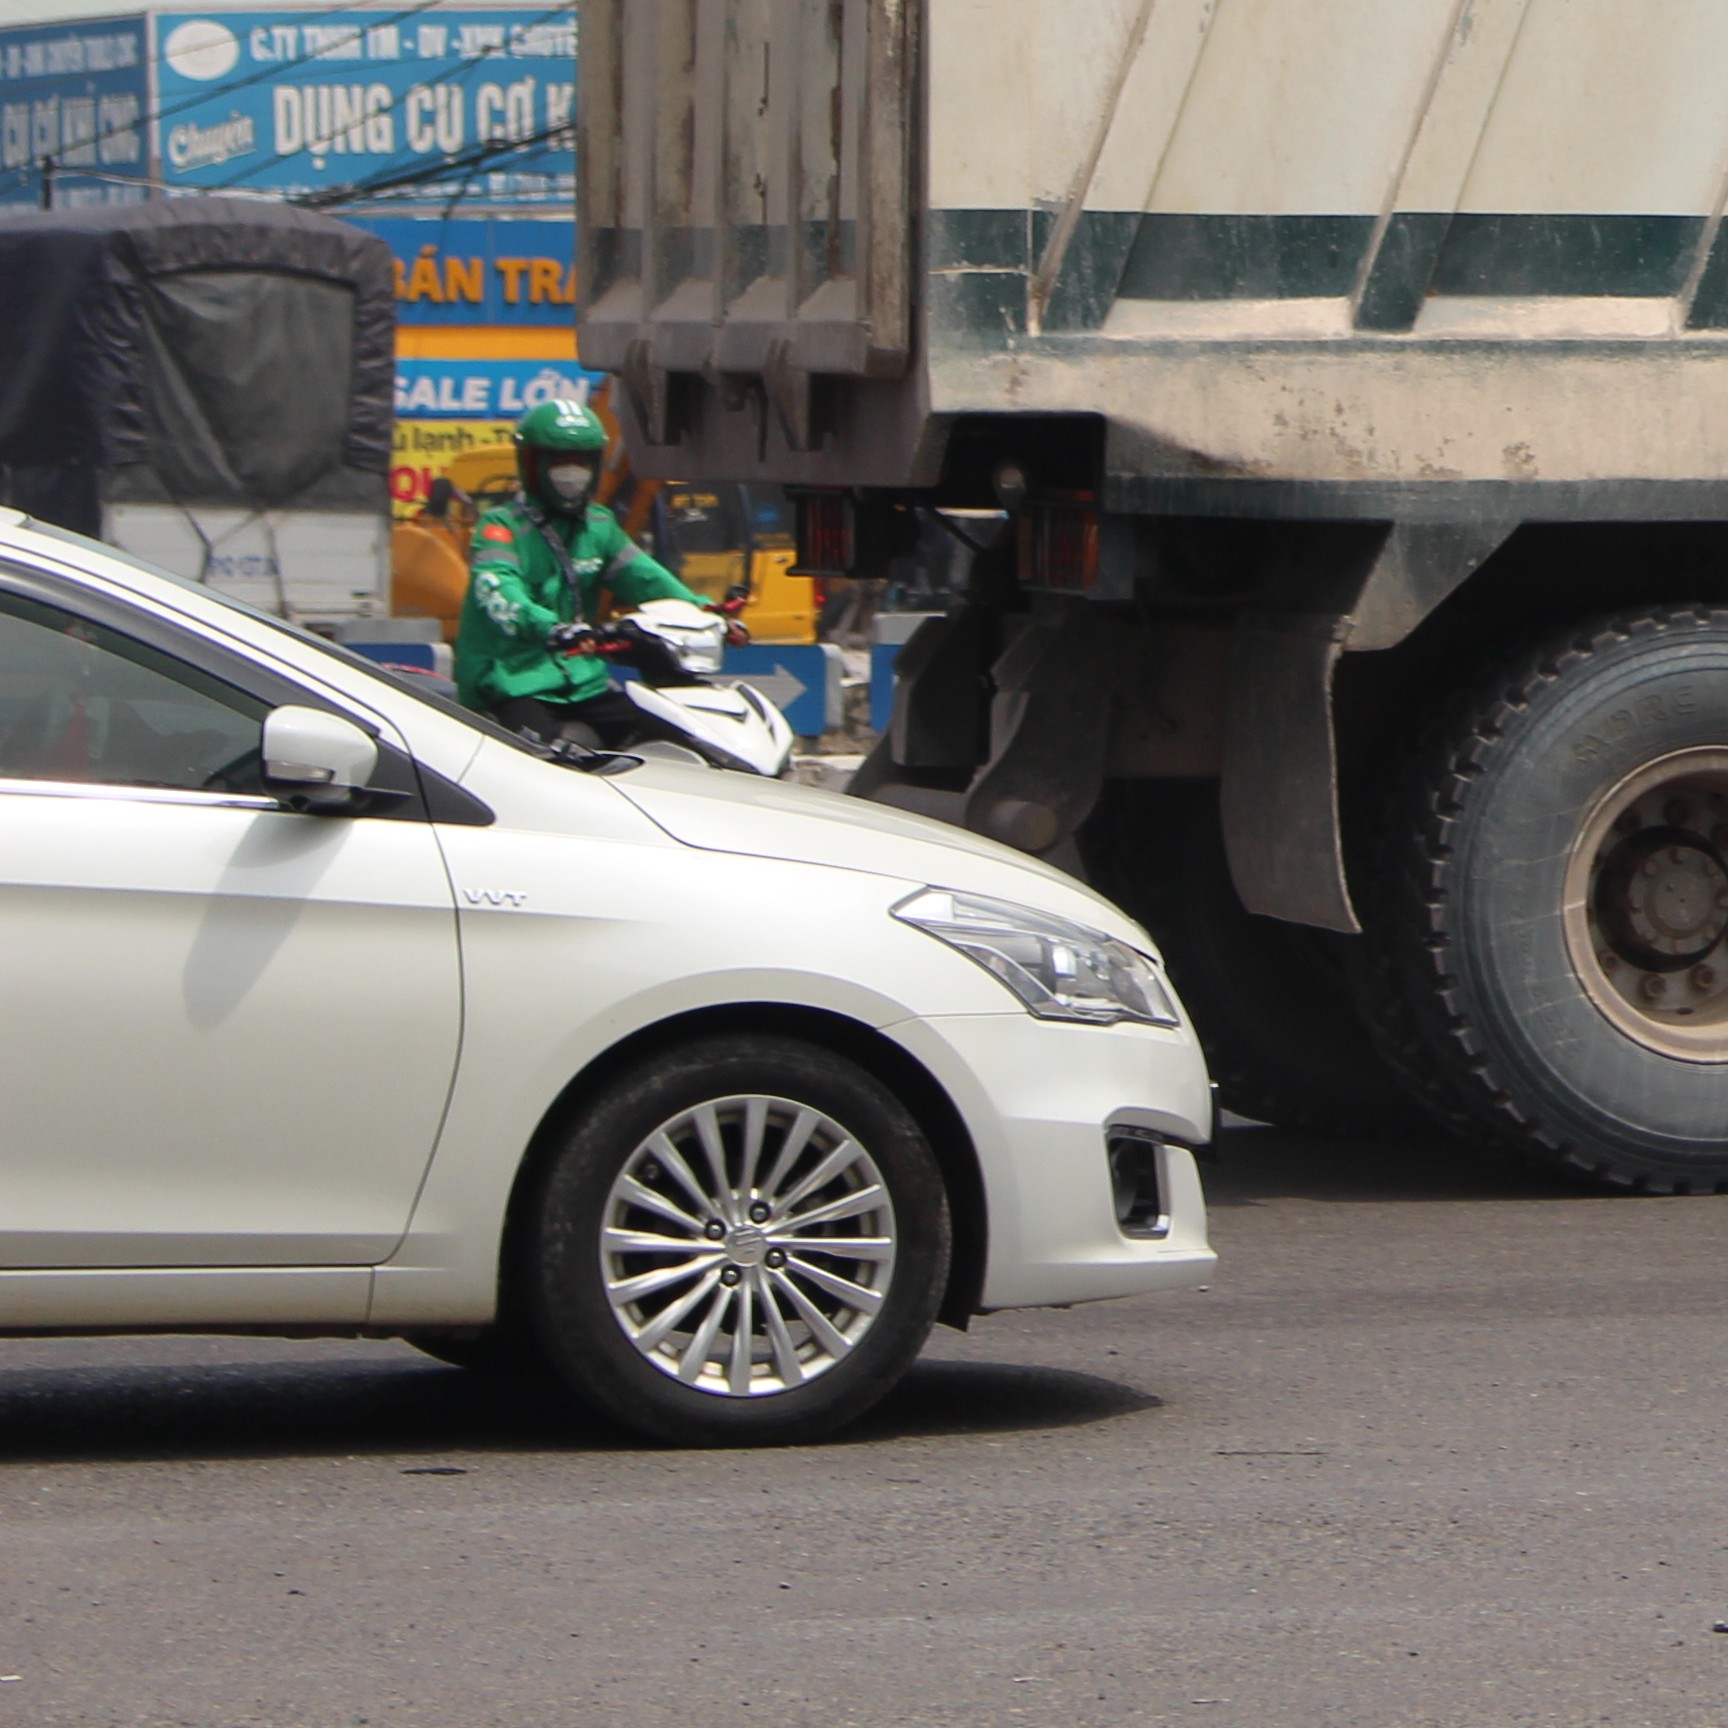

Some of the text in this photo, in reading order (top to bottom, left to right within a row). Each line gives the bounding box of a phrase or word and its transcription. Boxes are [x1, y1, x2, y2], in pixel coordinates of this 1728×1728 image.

[274, 83, 395, 170] DỤNG
[405, 83, 463, 164] CỤ
[476, 75, 535, 152] CƠ
[394, 376, 490, 410] SALE
[463, 888, 528, 907] VVT
